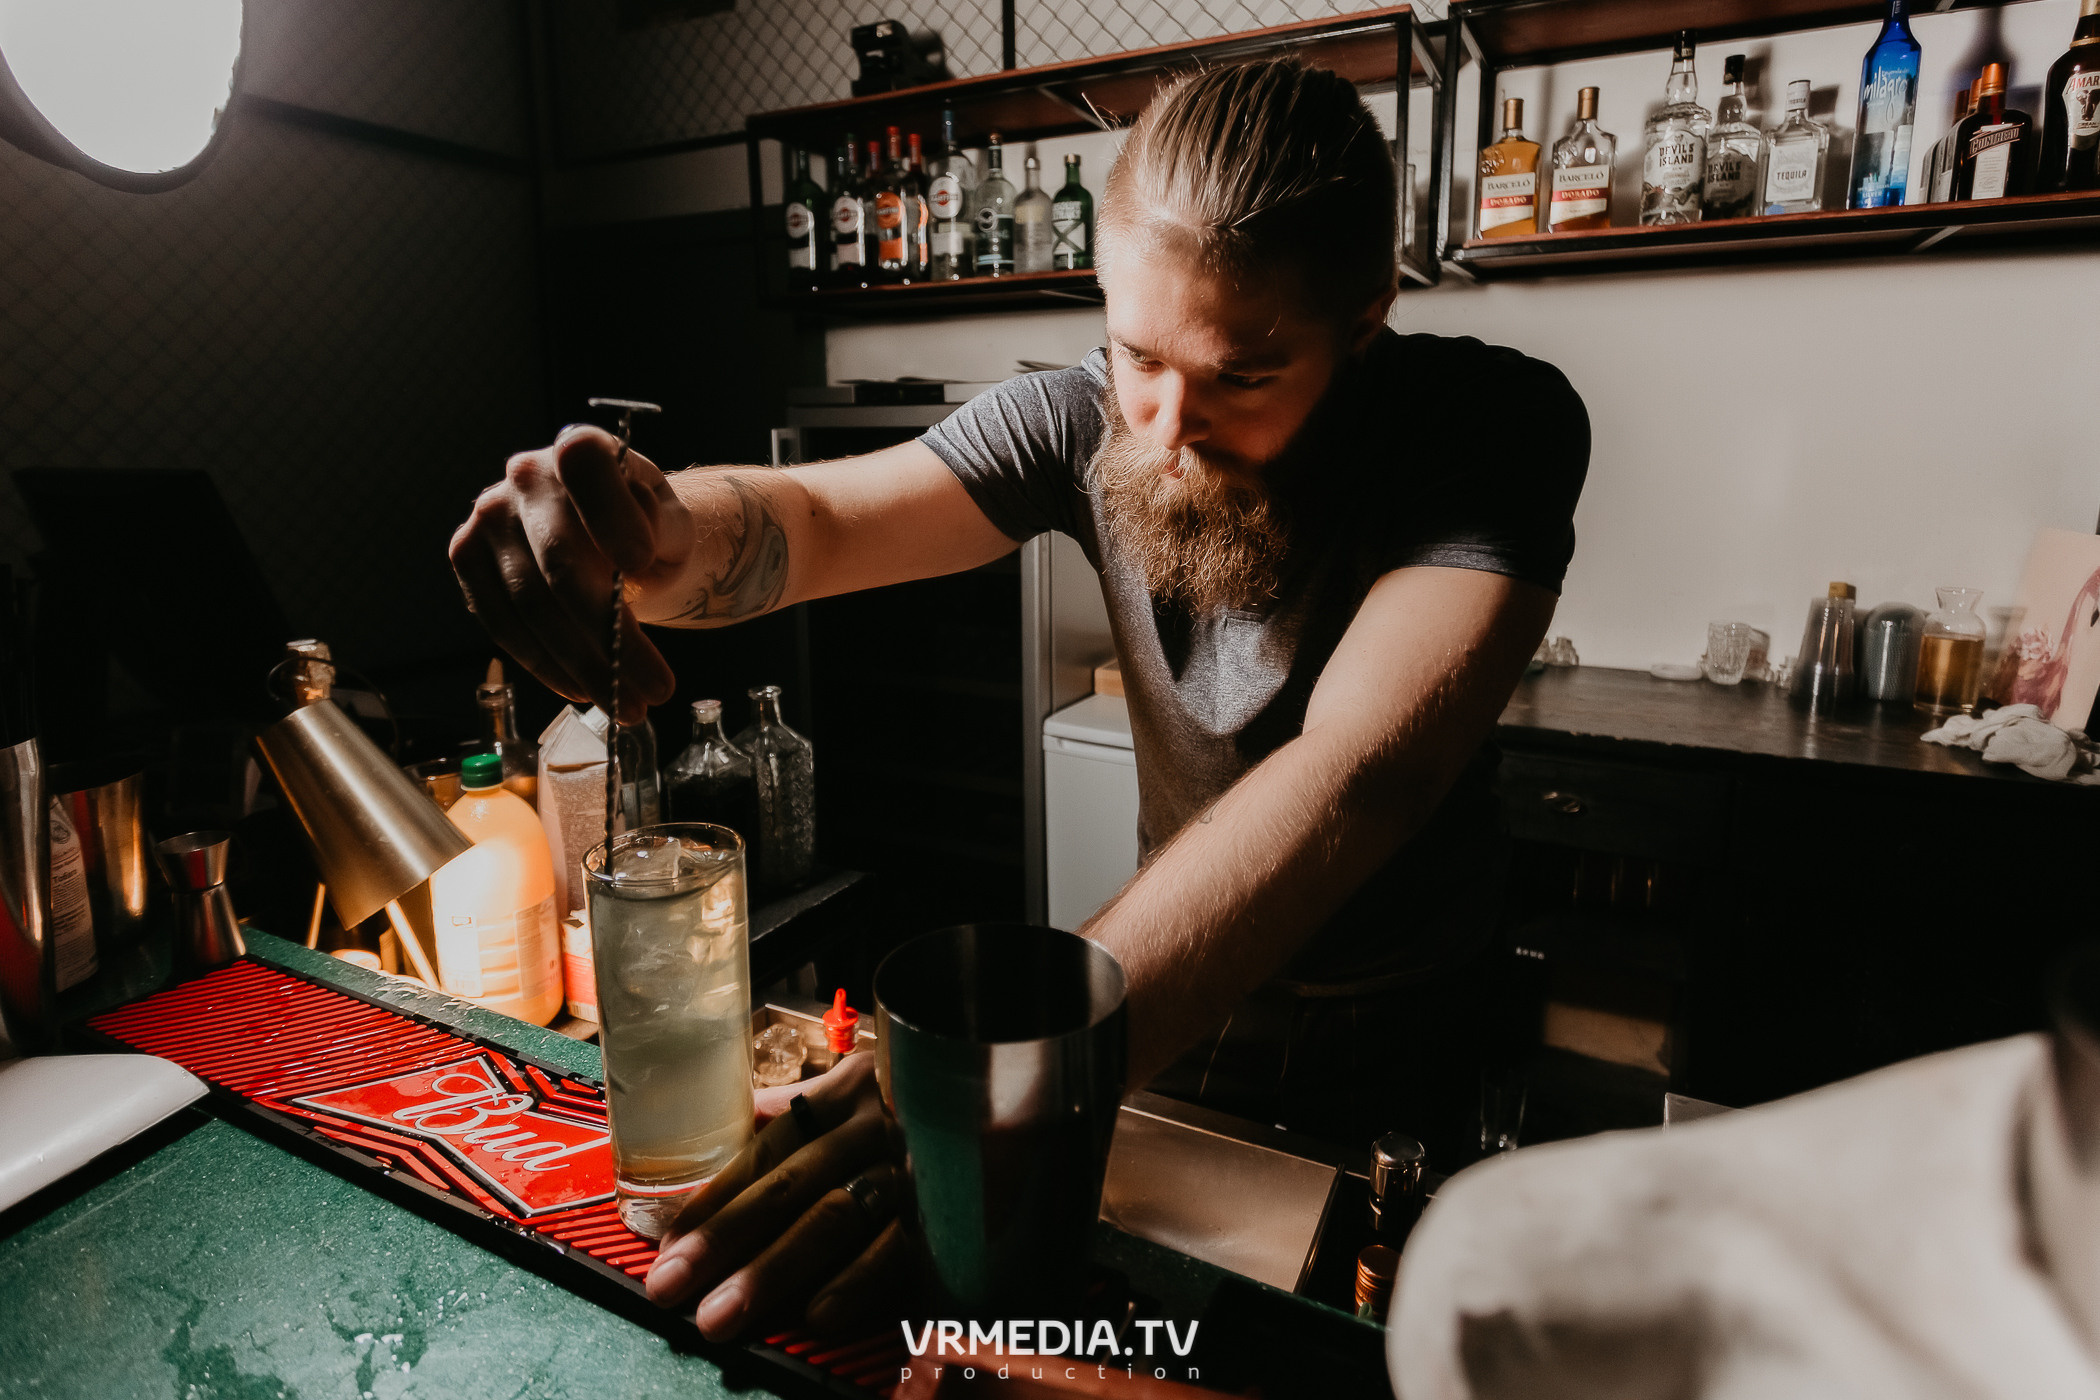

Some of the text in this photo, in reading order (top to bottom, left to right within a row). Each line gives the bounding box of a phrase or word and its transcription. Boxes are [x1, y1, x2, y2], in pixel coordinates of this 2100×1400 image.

[1863, 65, 1908, 102] milagro
[1659, 153, 1694, 167] ISLAND
[1776, 169, 1807, 181] TEQUILA
[1561, 189, 1600, 199] DORADO
[392, 1072, 571, 1172] Bud
